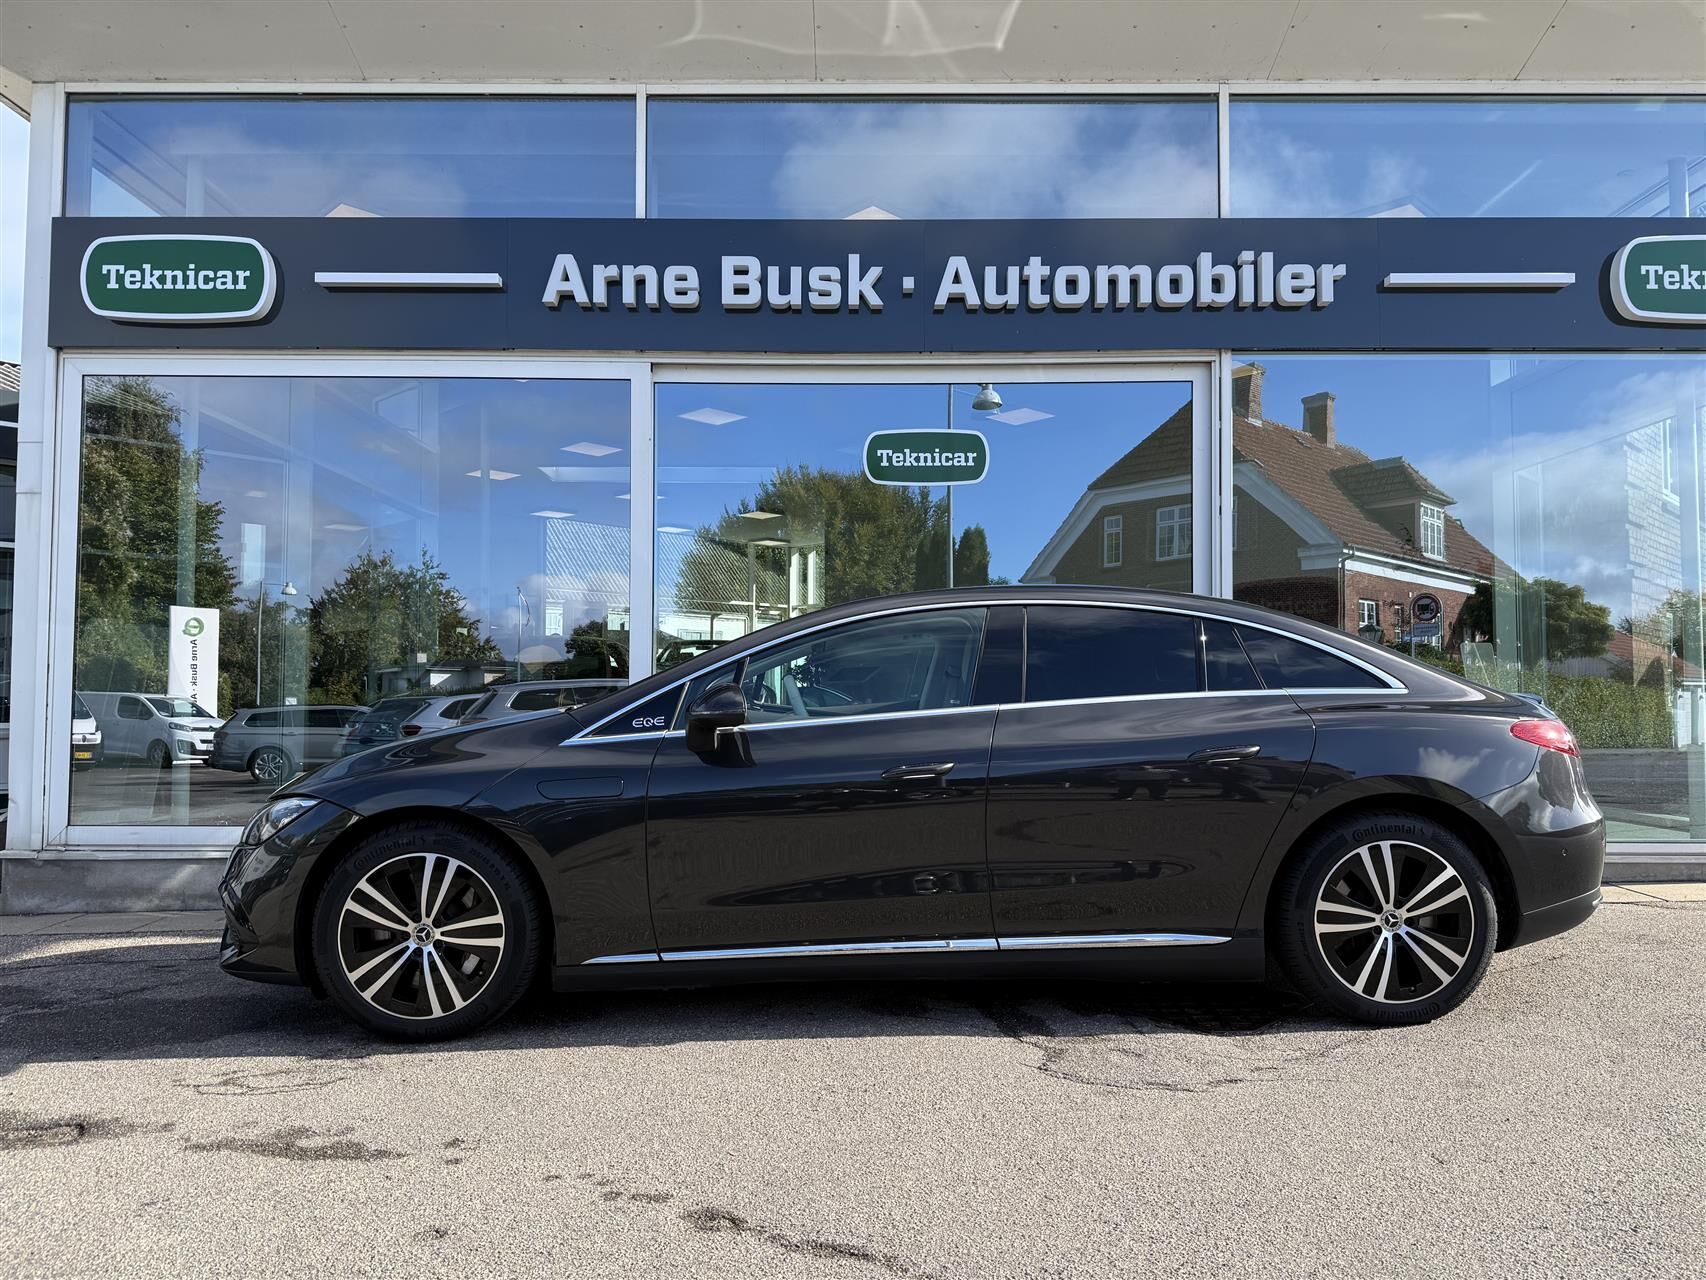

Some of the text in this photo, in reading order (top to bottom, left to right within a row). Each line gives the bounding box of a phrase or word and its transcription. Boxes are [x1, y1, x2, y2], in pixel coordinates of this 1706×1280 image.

[102, 263, 251, 292] Teknicar
[541, 253, 700, 309] Arne
[721, 253, 884, 310] Busk
[932, 250, 1347, 310] Automobiler
[876, 448, 977, 467] Teknicar
[632, 716, 665, 728] EQE
[1351, 823, 1417, 842] Continental
